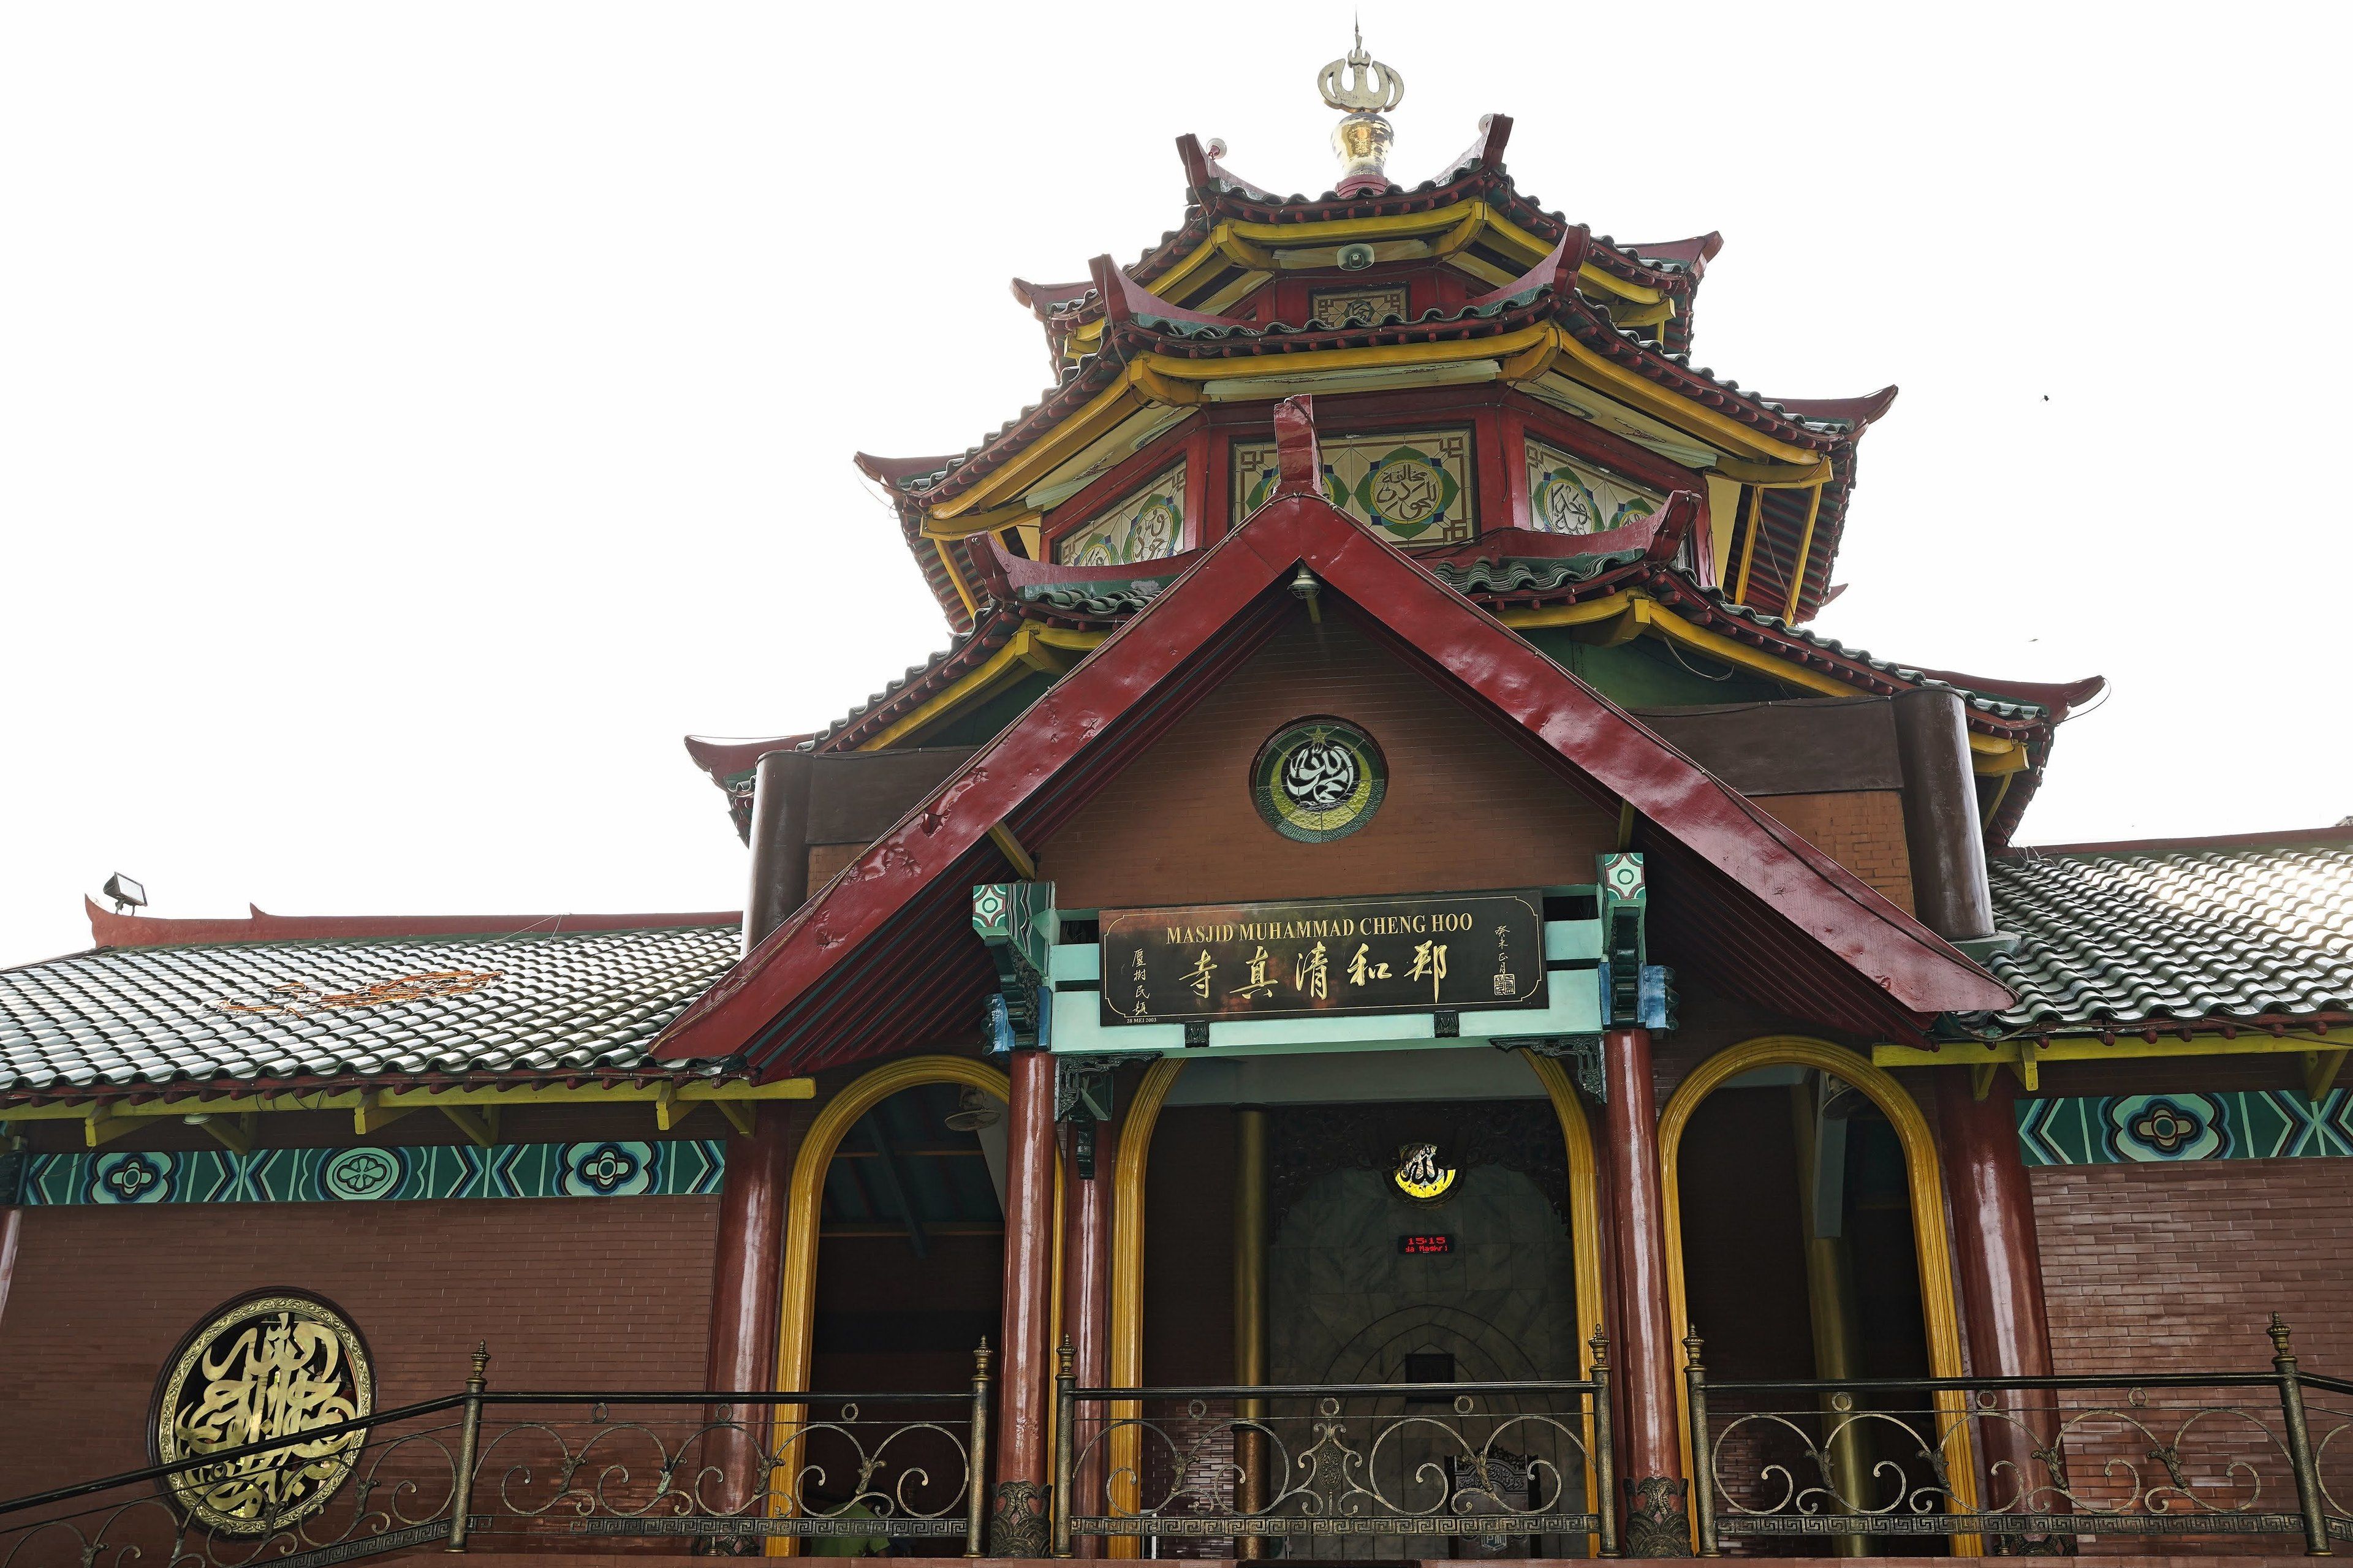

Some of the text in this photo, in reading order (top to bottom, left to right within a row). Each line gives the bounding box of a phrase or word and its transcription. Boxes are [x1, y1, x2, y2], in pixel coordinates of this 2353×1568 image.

[1165, 912, 1473, 944] MASJID MUHAMMAD CHENG HOO
